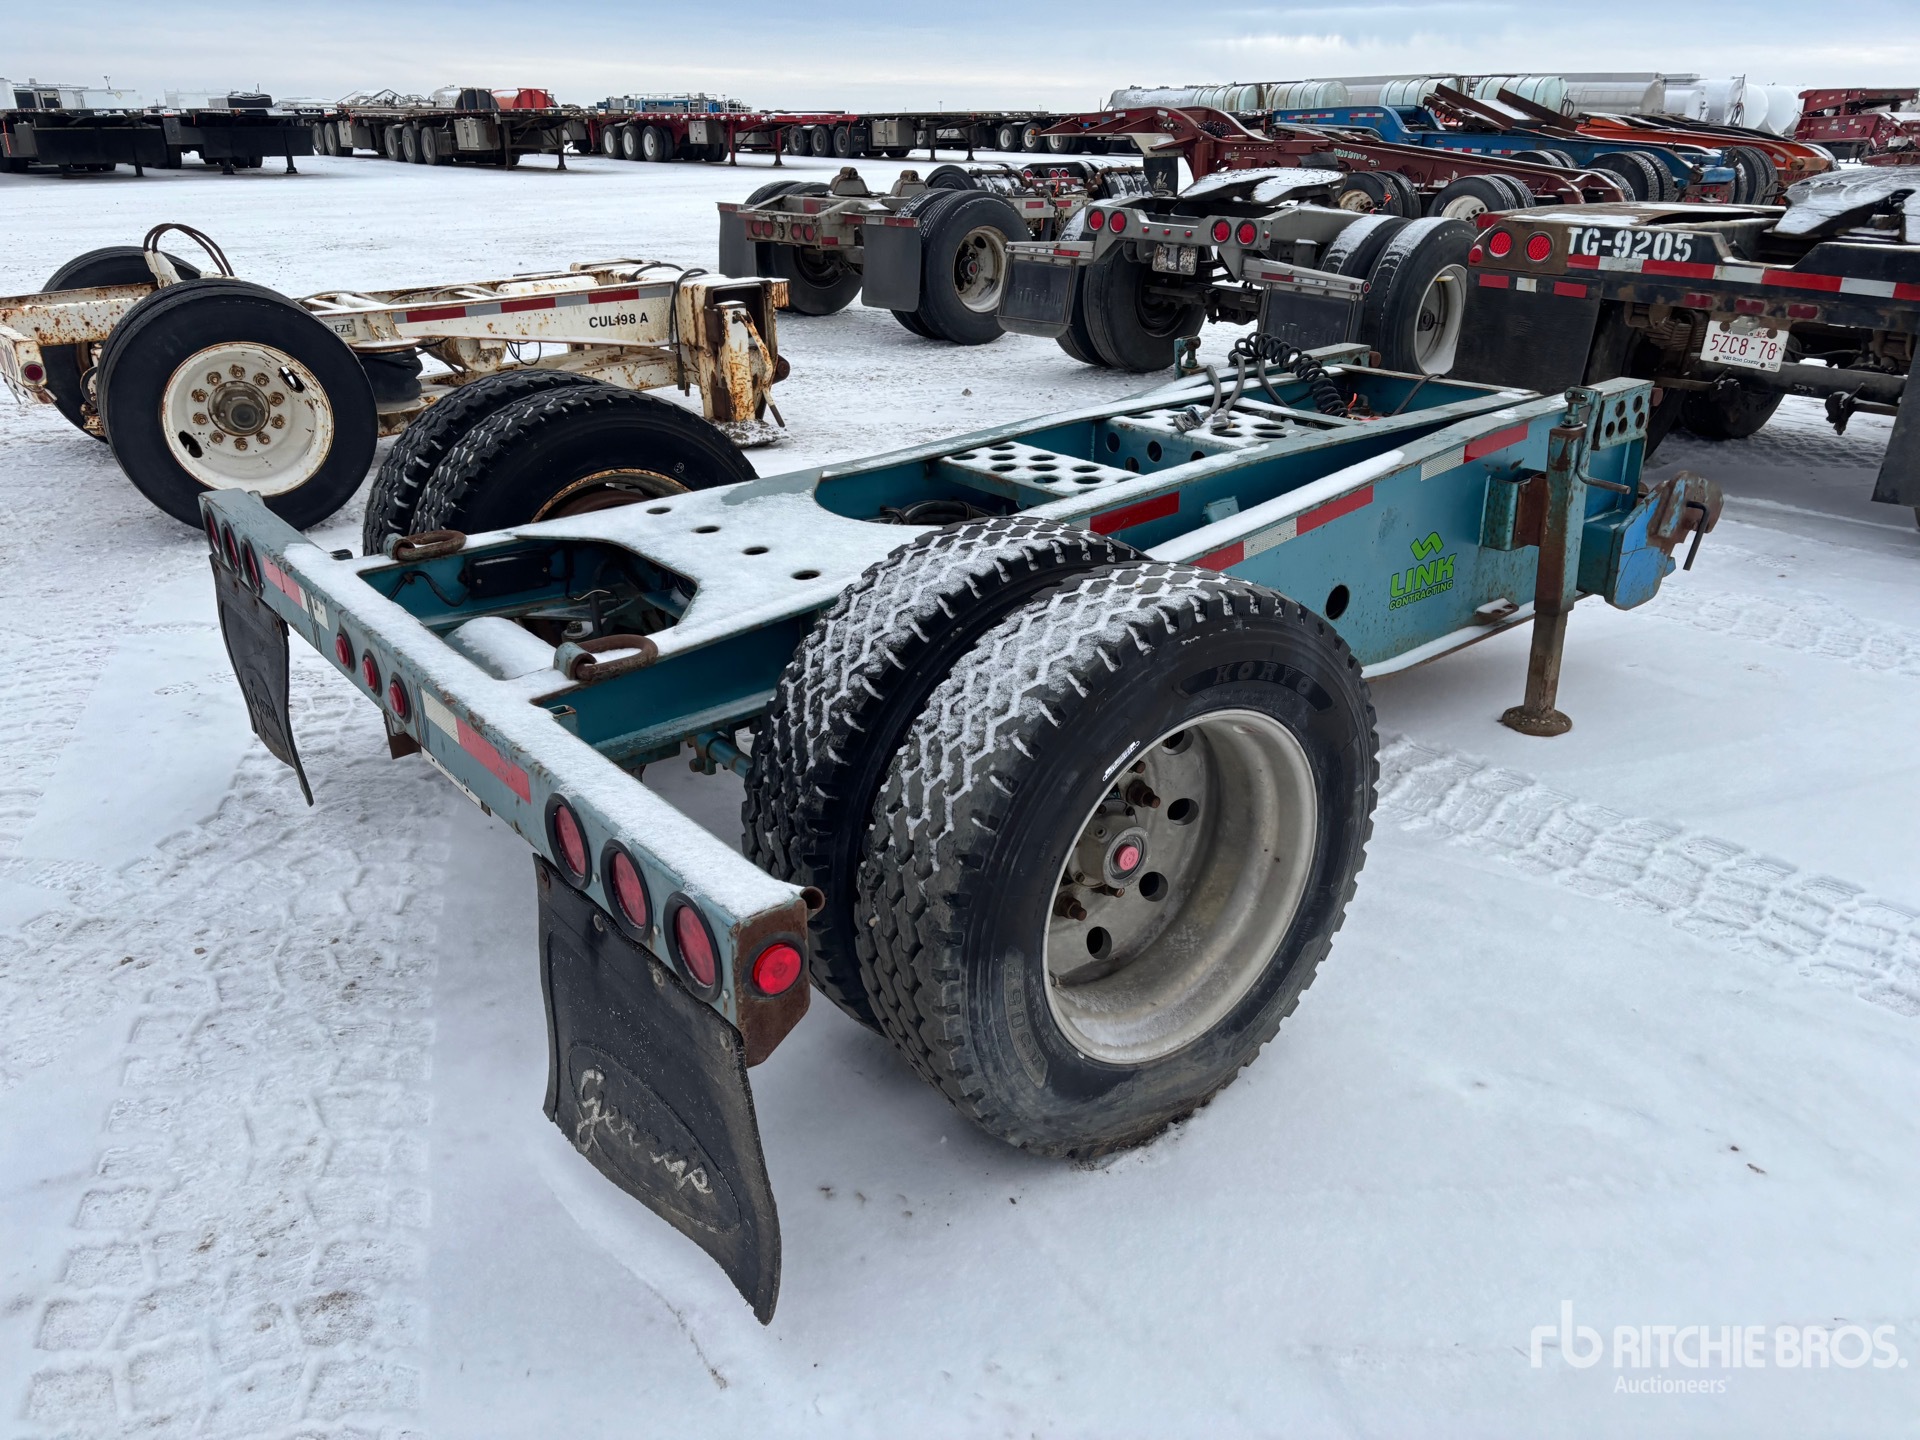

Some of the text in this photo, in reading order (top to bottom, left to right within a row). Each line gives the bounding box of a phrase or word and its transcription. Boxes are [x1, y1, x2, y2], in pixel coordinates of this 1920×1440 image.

[1567, 227, 1693, 262] TG-9205
[589, 312, 649, 328] CUL198 A
[1710, 334, 1777, 360] 5ZC8-78
[1390, 553, 1457, 598] LINK
[1389, 580, 1453, 611] CONTRACTING
[1213, 661, 1314, 695] KORYO
